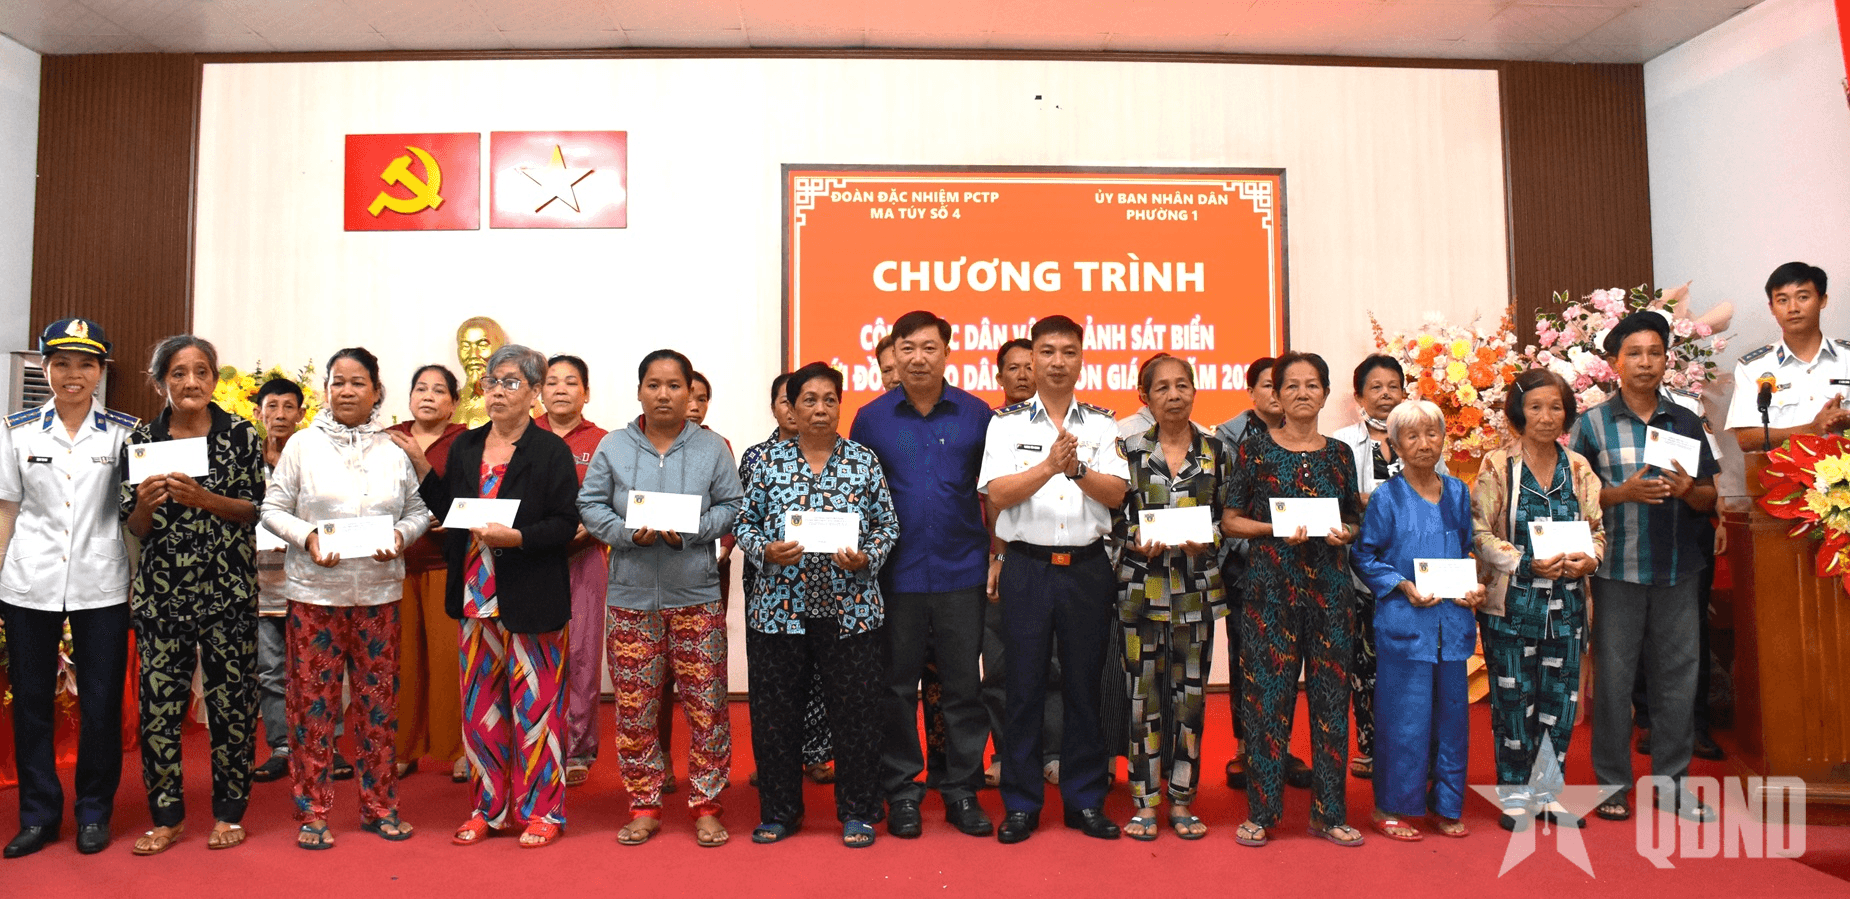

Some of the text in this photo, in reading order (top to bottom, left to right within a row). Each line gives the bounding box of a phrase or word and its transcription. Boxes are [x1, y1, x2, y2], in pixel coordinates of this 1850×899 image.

[831, 188, 999, 206] ĐOÀN ĐẶC NHIỆM PCTP
[1095, 189, 1229, 206] ỦY BAN NHÂN DÂN
[870, 205, 961, 219] MA TÚY SỐ 4
[1126, 207, 1198, 221] PHƯỜNG 1
[873, 253, 1205, 292] CHƯƠNG TRÌNH
[964, 317, 1008, 350] DÂN
[1082, 315, 1126, 350] ẢNH
[1130, 317, 1166, 350] SÁT
[1171, 314, 1215, 350] BIỂN
[1107, 357, 1138, 391] GIÁ
